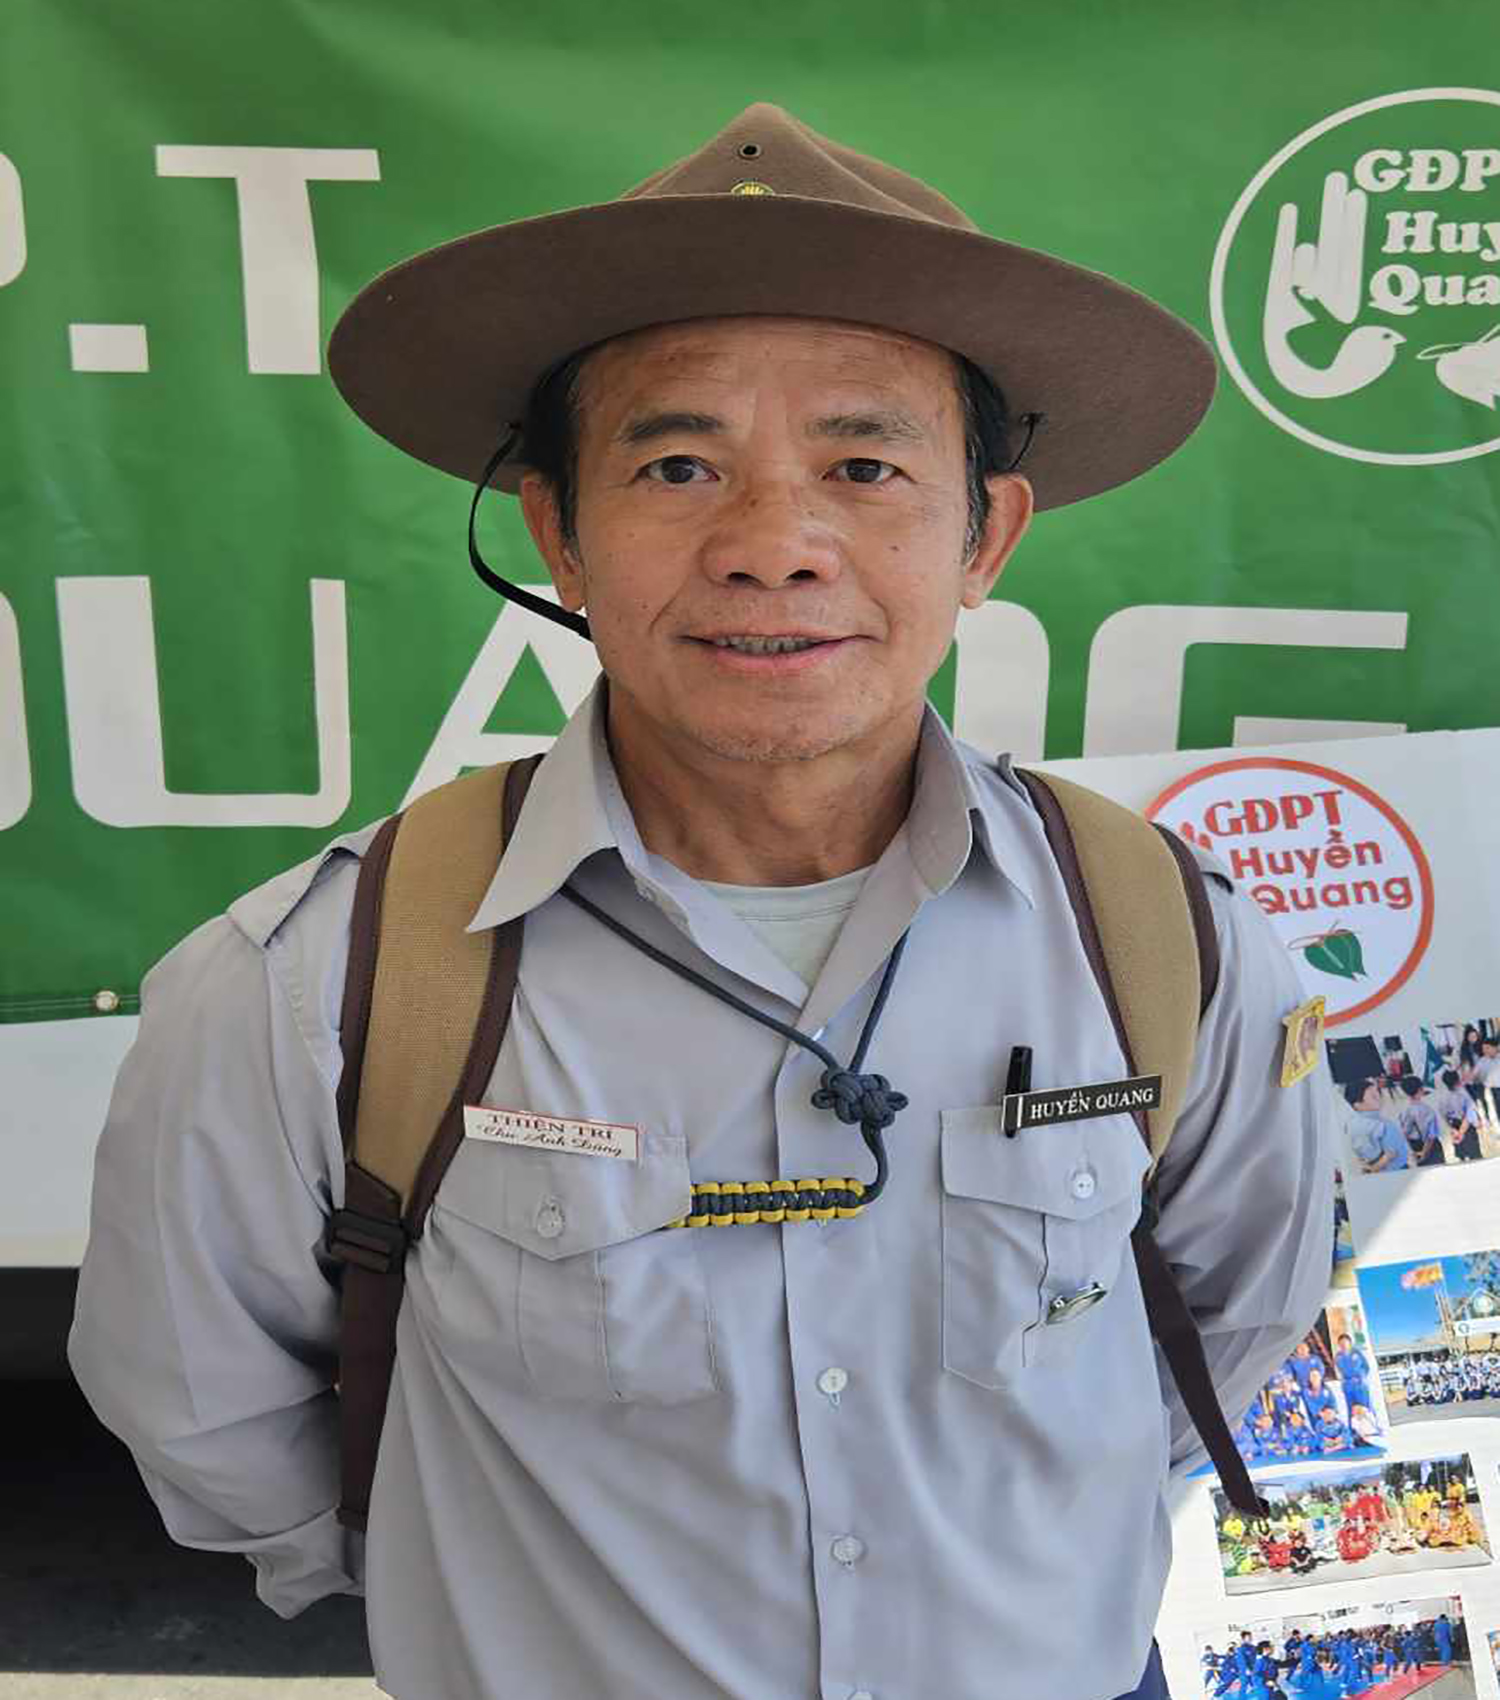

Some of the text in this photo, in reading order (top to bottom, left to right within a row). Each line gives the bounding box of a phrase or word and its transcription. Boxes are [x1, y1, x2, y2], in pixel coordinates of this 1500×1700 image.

[1204, 790, 1344, 837] GĐPT
[1229, 829, 1383, 878] Huyền
[1251, 876, 1414, 915] Quang
[1031, 1087, 1154, 1120] HUYỀN QUANG
